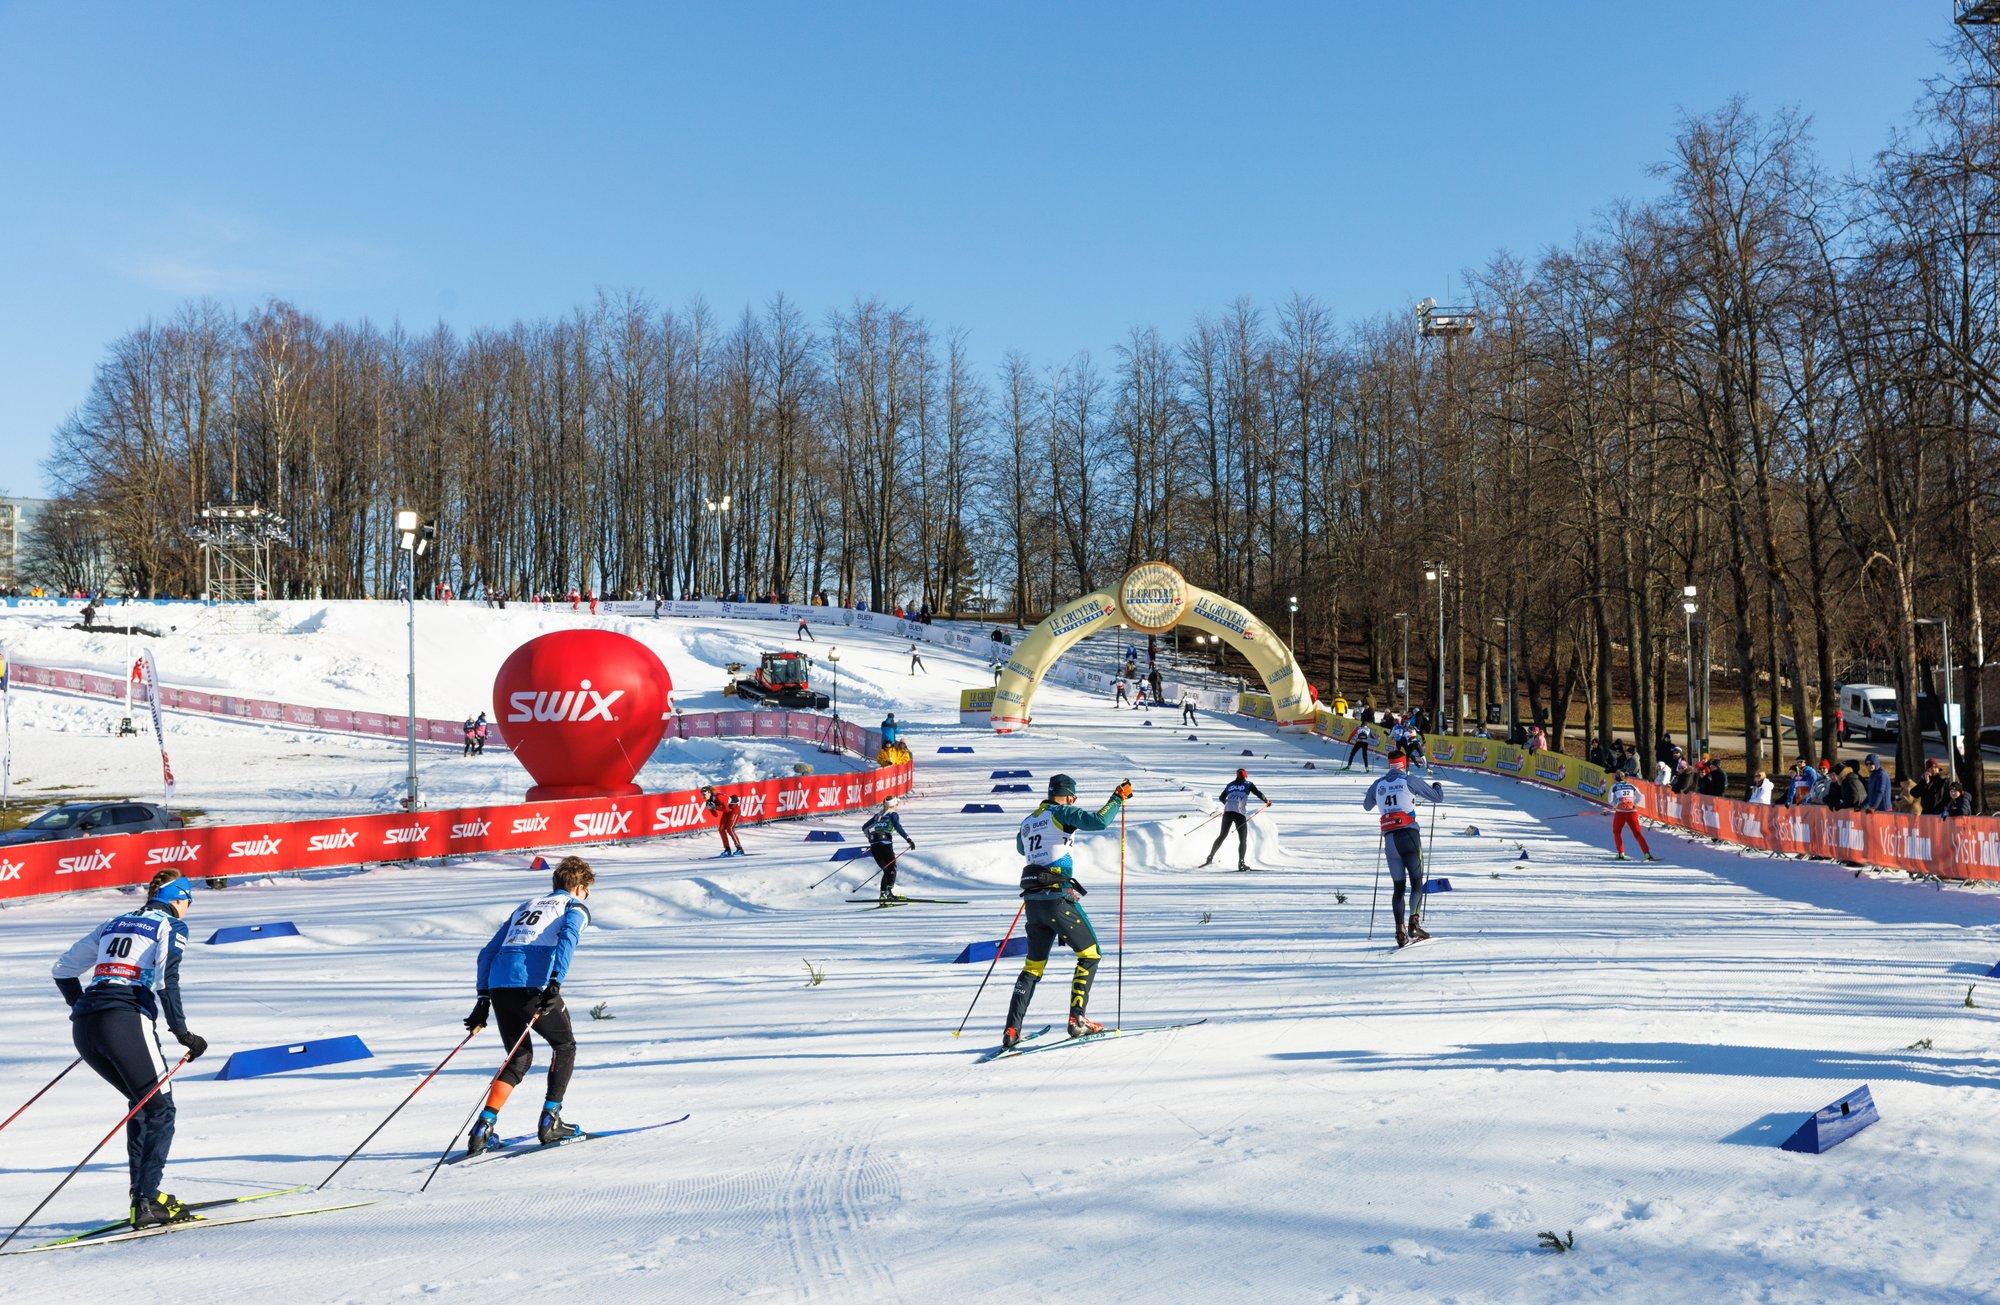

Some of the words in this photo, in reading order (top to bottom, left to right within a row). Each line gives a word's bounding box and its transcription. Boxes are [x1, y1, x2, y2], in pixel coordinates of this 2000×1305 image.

[1198, 597, 1208, 610] LE
[908, 624, 923, 632] BUEN
[1049, 618, 1059, 631] LE
[1055, 610, 1104, 636] SWITZERLAND
[956, 634, 971, 644] BUEN
[1385, 794, 1398, 807] 41
[1033, 820, 1048, 829] BUEN
[1880, 825, 1901, 858] Visit
[1903, 828, 1932, 860] Tallinn
[1952, 830, 1977, 864] Visit
[514, 910, 542, 926] 26
[106, 937, 132, 958] 40
[560, 1134, 587, 1146] SALOMON
